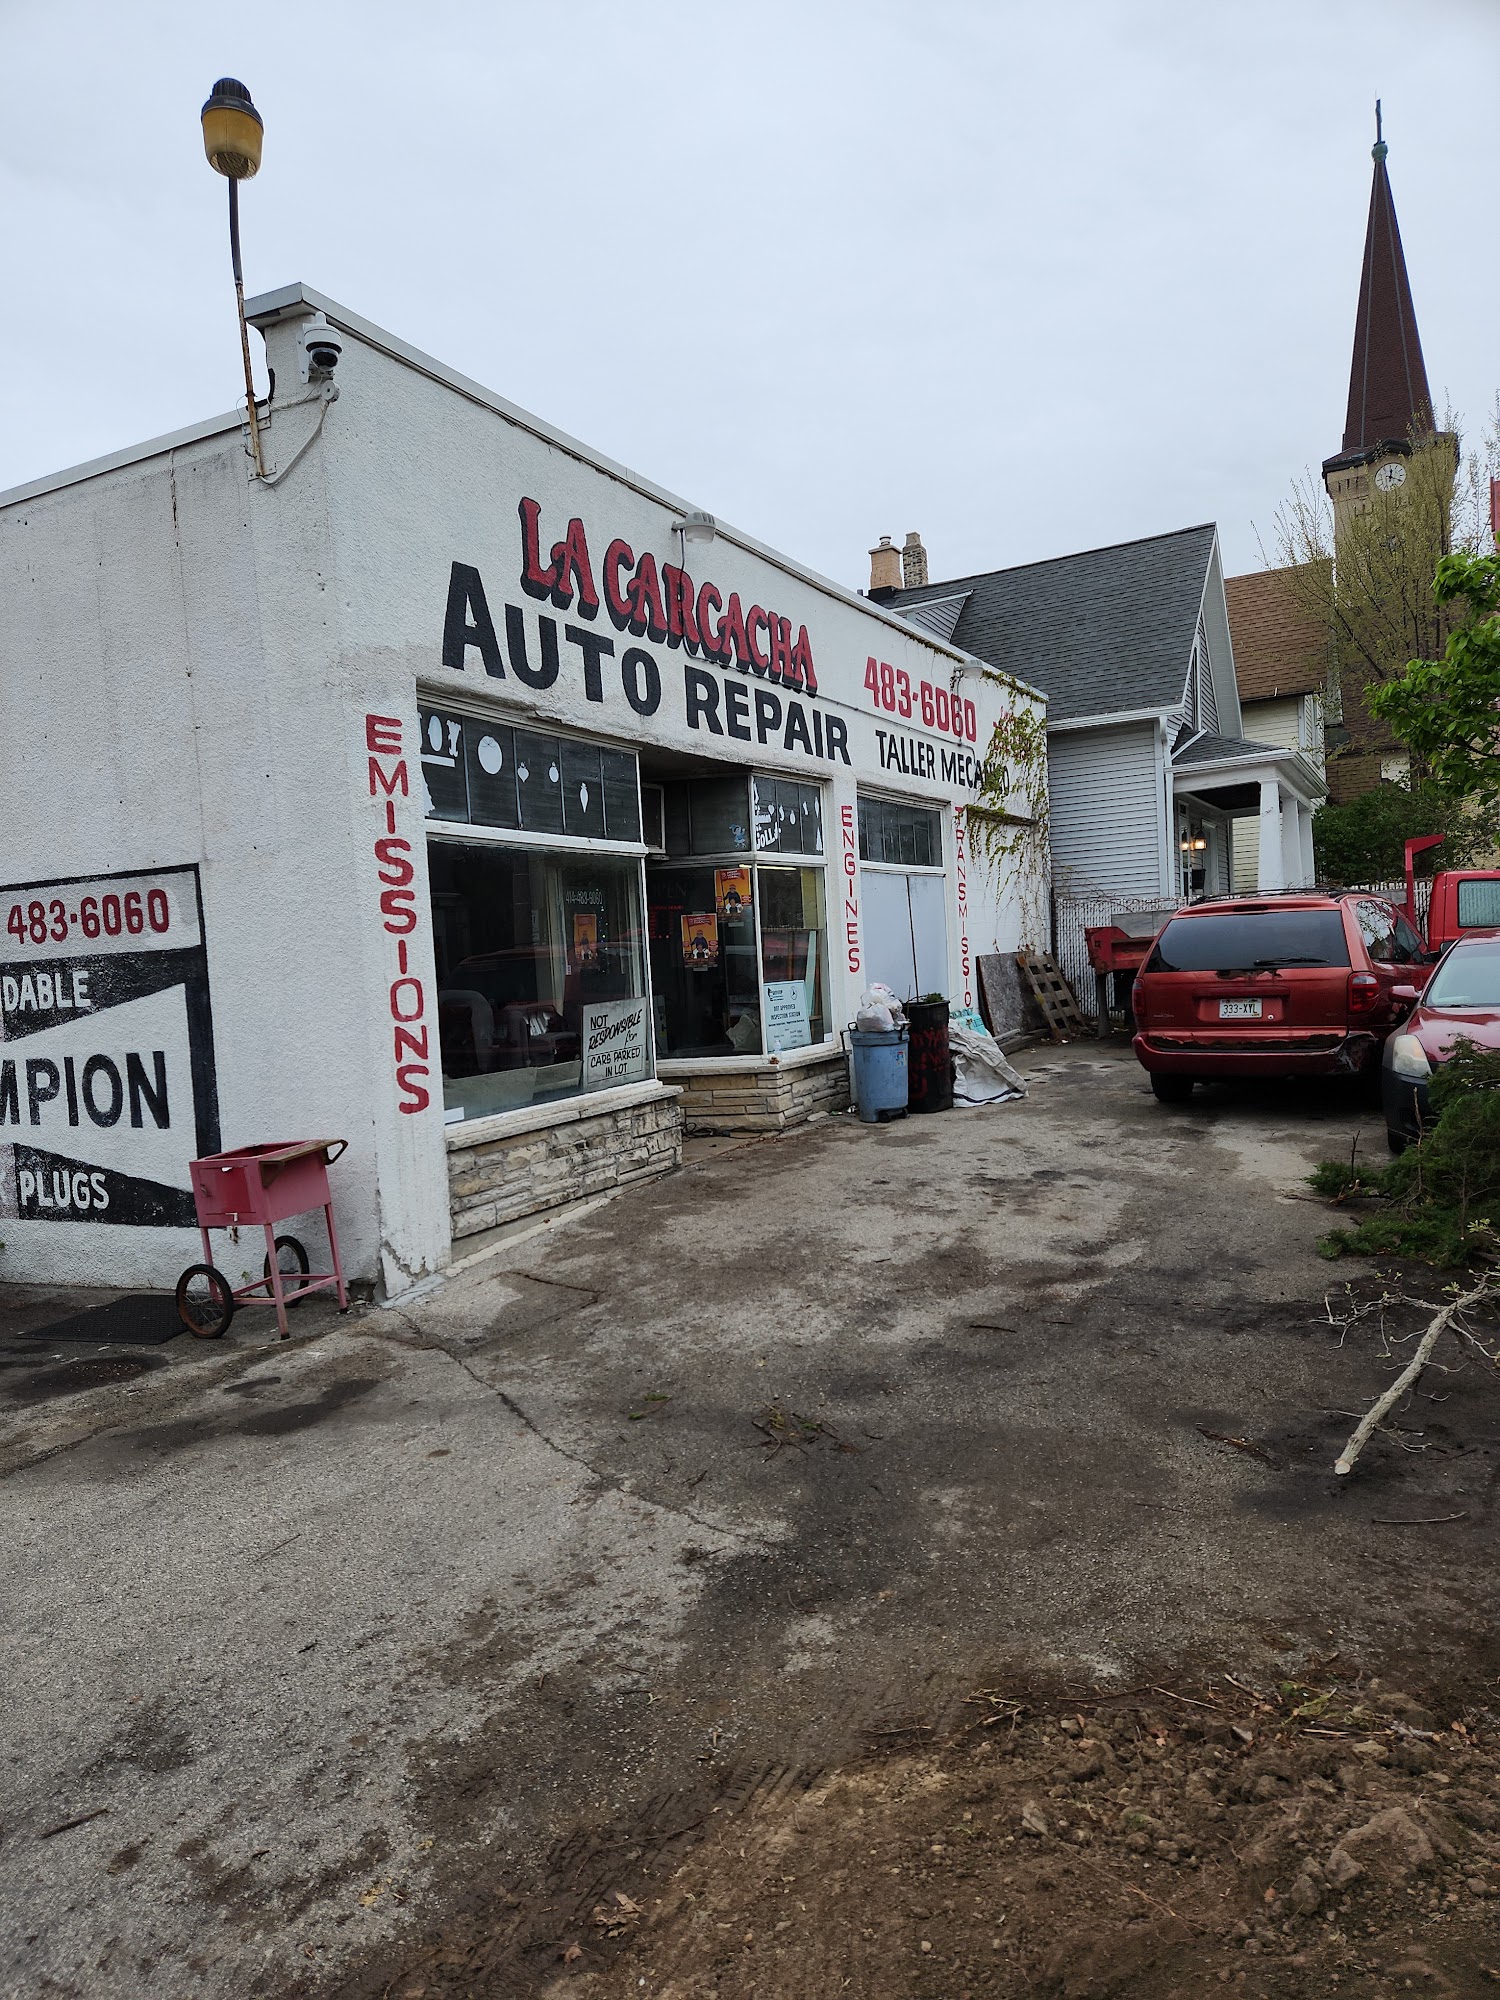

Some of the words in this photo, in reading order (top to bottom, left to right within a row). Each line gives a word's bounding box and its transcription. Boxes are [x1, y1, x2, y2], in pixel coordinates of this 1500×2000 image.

[518, 496, 599, 621] LA
[603, 538, 818, 698] CARCACHA
[442, 560, 661, 716] AUTO
[684, 664, 852, 766] REPAIR
[875, 729, 936, 780] TALLER
[941, 748, 1010, 797] MECAO
[366, 714, 430, 1114] EMISSIONS
[841, 805, 861, 973] ENGINES
[588, 1008, 643, 1053] RESPONSIBLE
[590, 1014, 608, 1029] NOT
[591, 1053, 612, 1068] CARS
[614, 1047, 641, 1063] PARKED
[605, 1066, 612, 1078] IN
[615, 1062, 628, 1075] LOT
[18, 1170, 110, 1210] PLUGS
